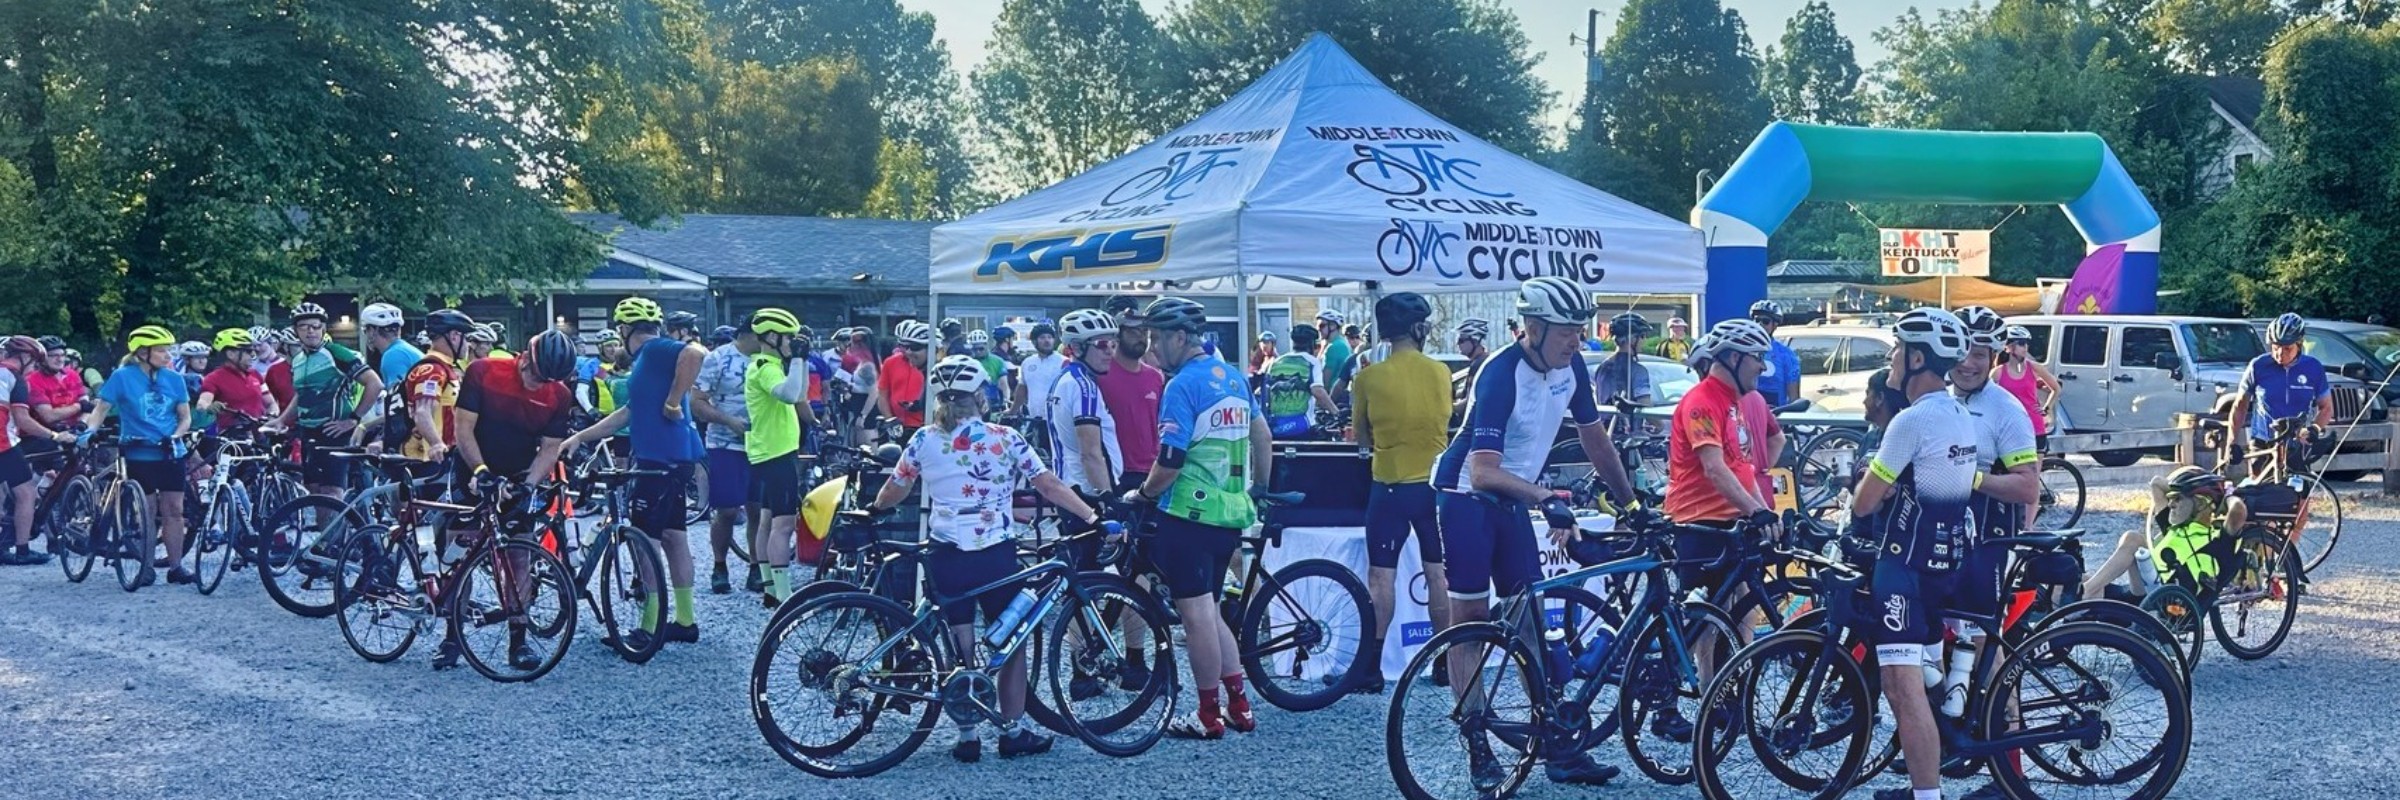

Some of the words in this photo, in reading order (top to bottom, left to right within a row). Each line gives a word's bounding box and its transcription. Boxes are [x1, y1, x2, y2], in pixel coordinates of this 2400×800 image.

[1059, 202, 1174, 223] CYCLING
[1385, 199, 1538, 217] CYCLING
[1883, 231, 1960, 249] OKHT
[977, 224, 1173, 276] KHS
[1883, 248, 1960, 257] KENTUCKY
[1467, 246, 1605, 284] CYCLING
[1211, 407, 1250, 427] OKHT
[1539, 549, 1571, 565] OWN
[1884, 594, 1903, 632] Oates
[1408, 627, 1433, 637] SALES
